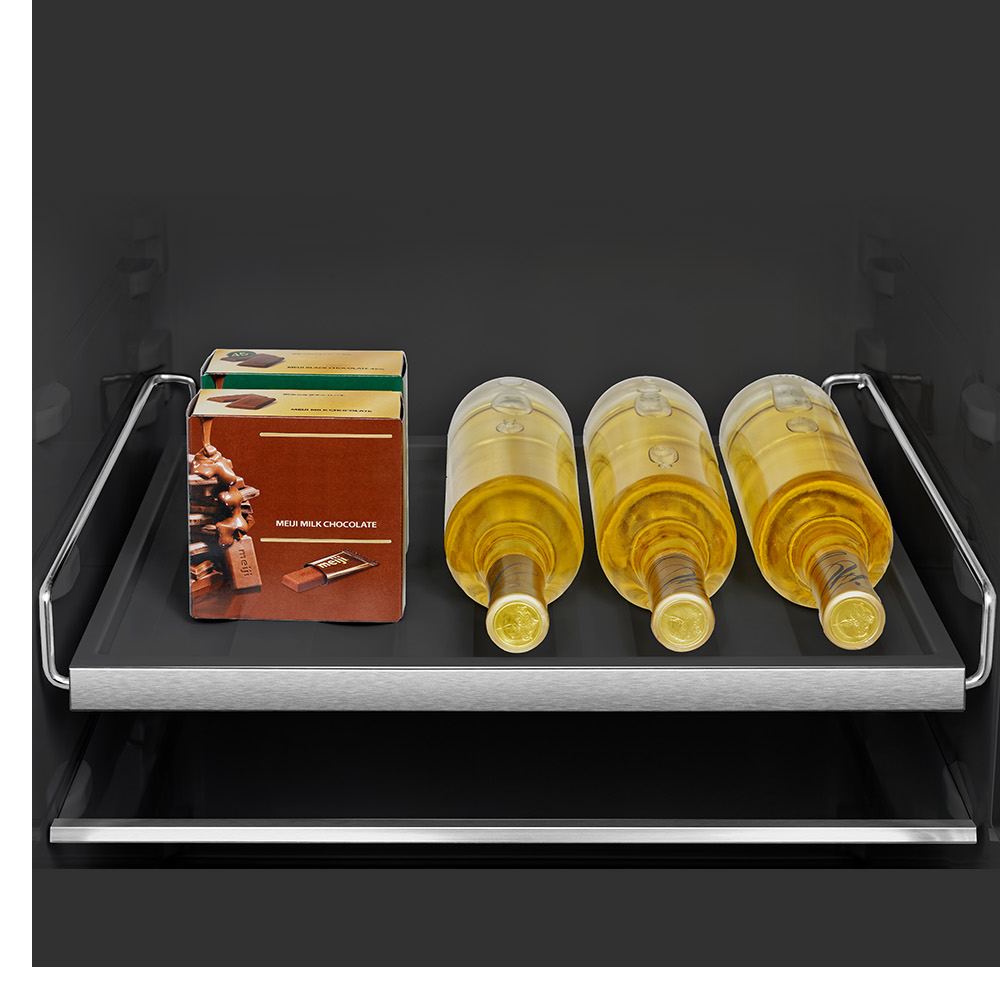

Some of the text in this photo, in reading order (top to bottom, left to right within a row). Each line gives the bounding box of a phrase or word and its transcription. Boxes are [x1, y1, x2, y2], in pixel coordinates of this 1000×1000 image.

[275, 520, 377, 529] MEIJI MILK CHOCOLATE
[238, 549, 252, 576] meiji
[317, 555, 347, 569] meiji
